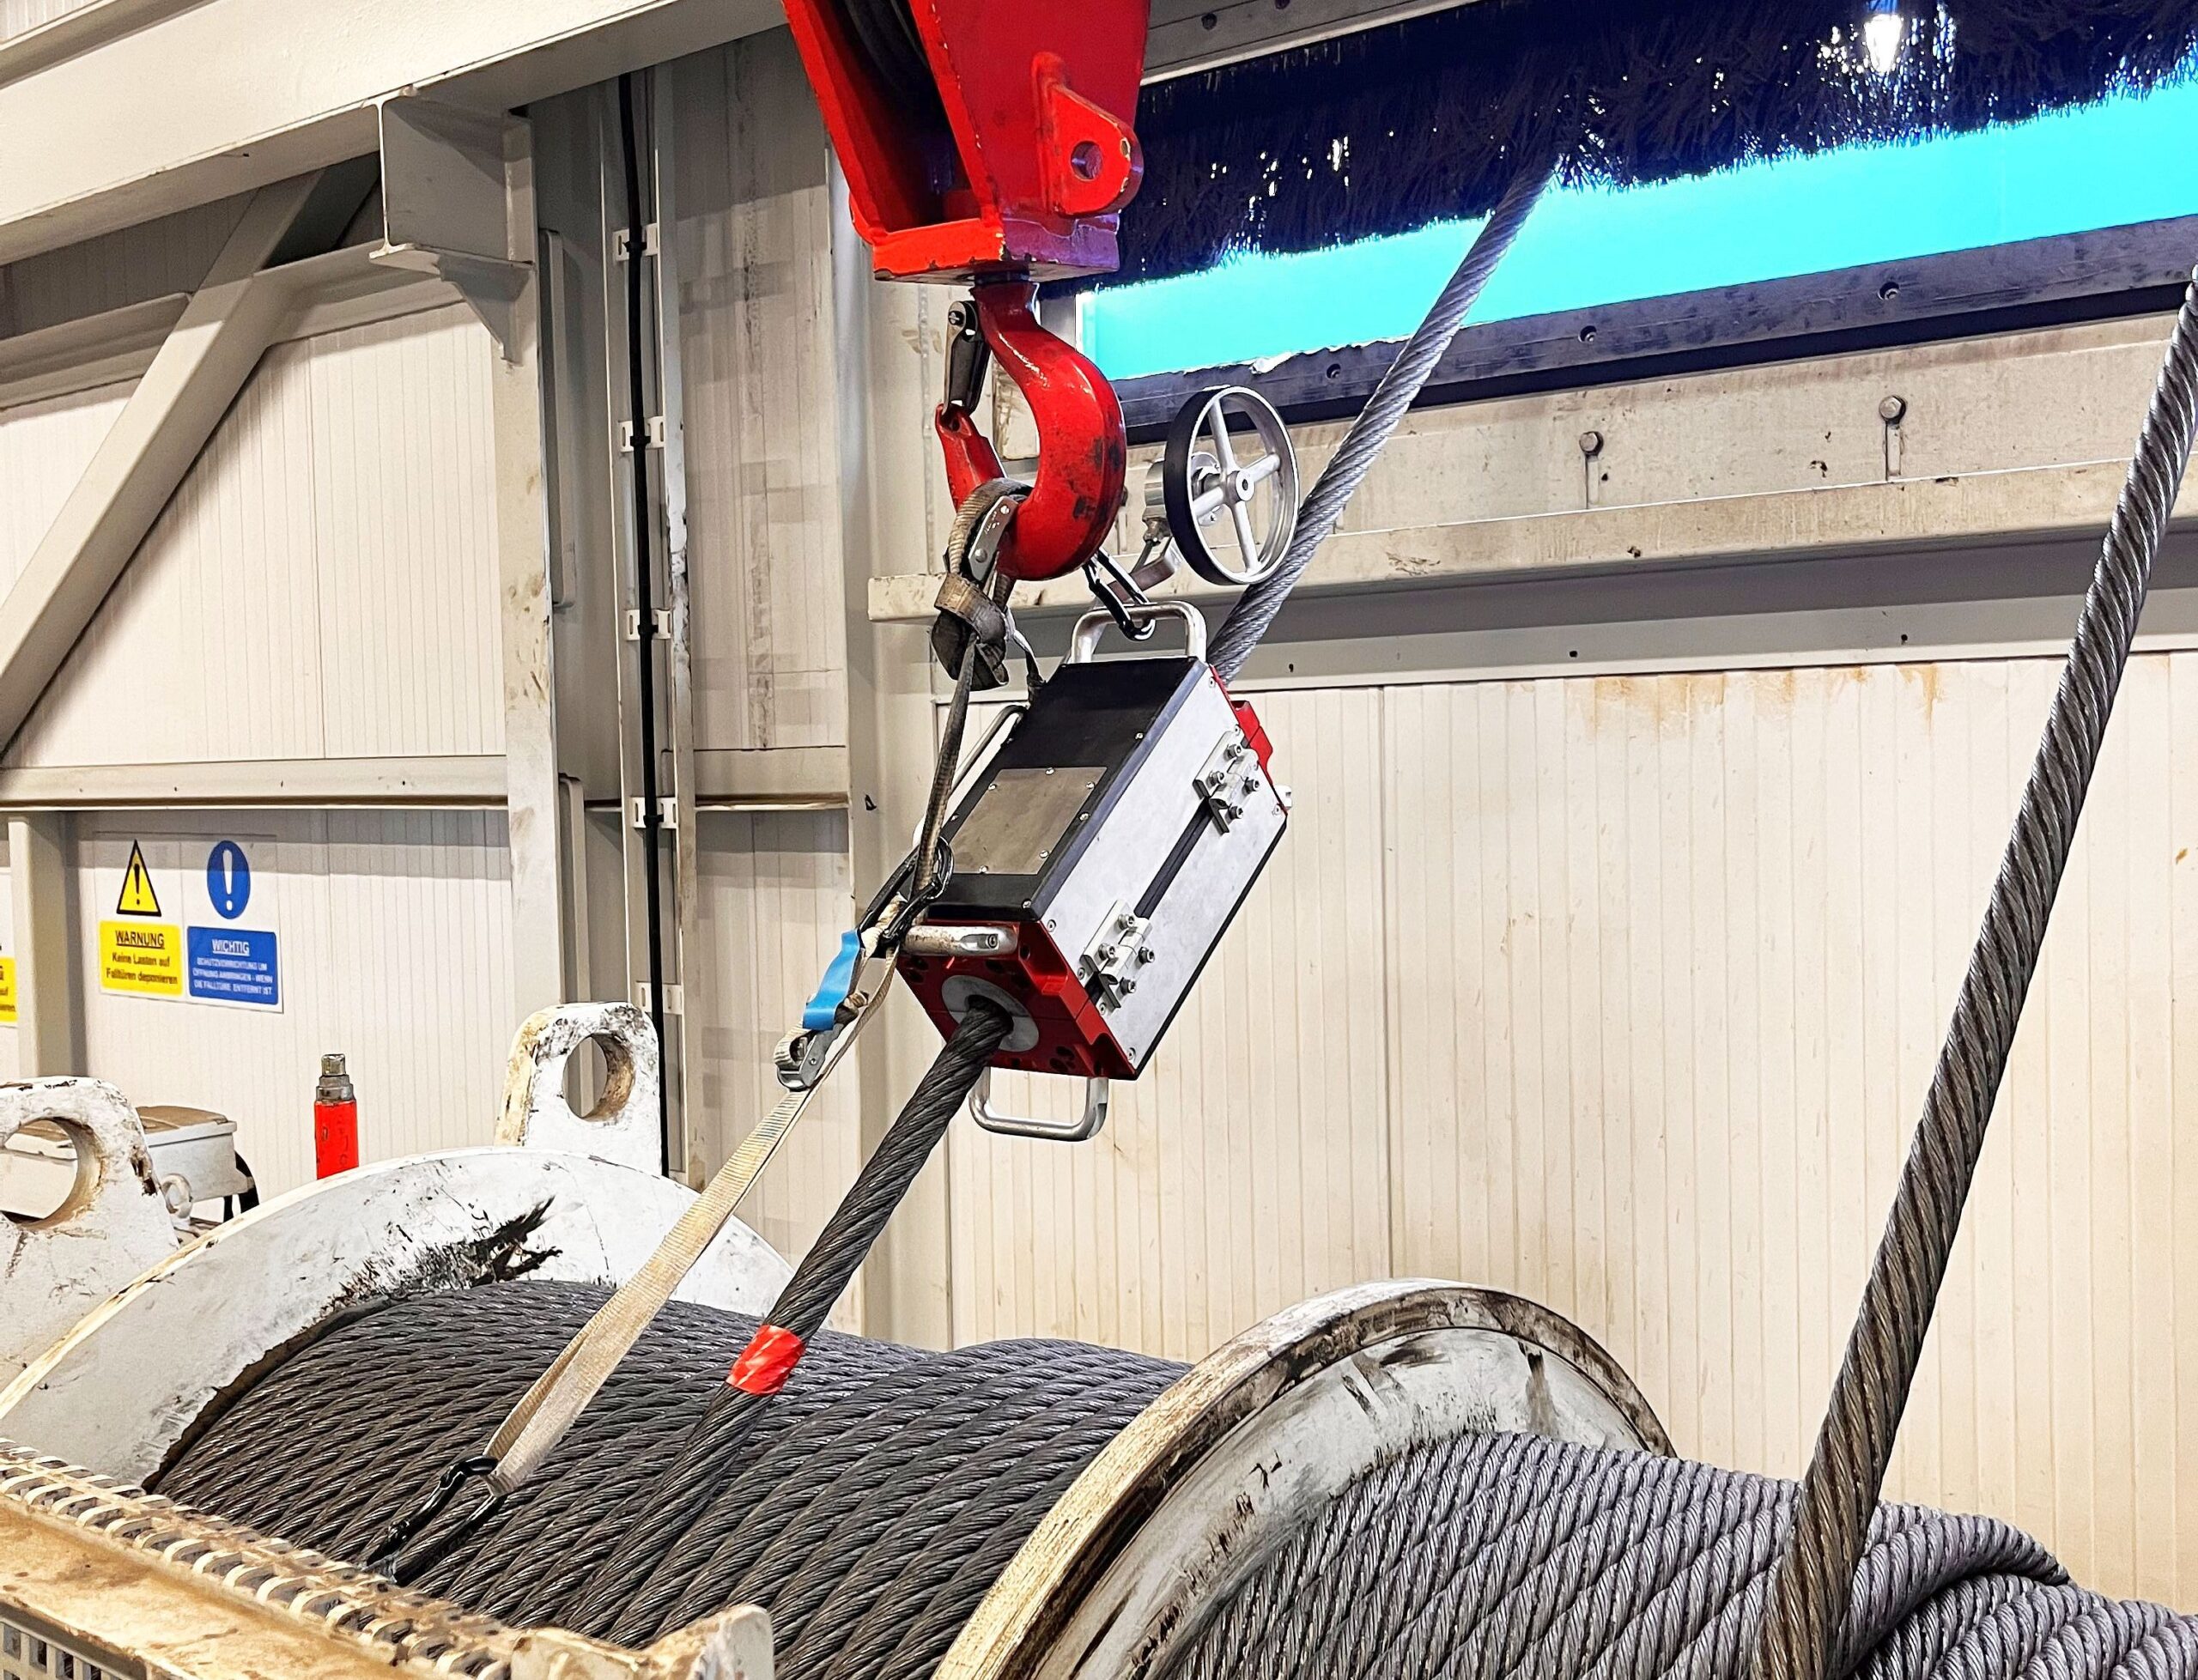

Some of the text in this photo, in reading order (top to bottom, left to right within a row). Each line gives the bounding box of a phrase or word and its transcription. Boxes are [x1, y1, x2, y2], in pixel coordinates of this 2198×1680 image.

[115, 931, 165, 949] WARNUNG
[211, 938, 250, 955] WICHTIG
[112, 951, 170, 967] Keine Lasten auf
[137, 970, 178, 985] deponieren
